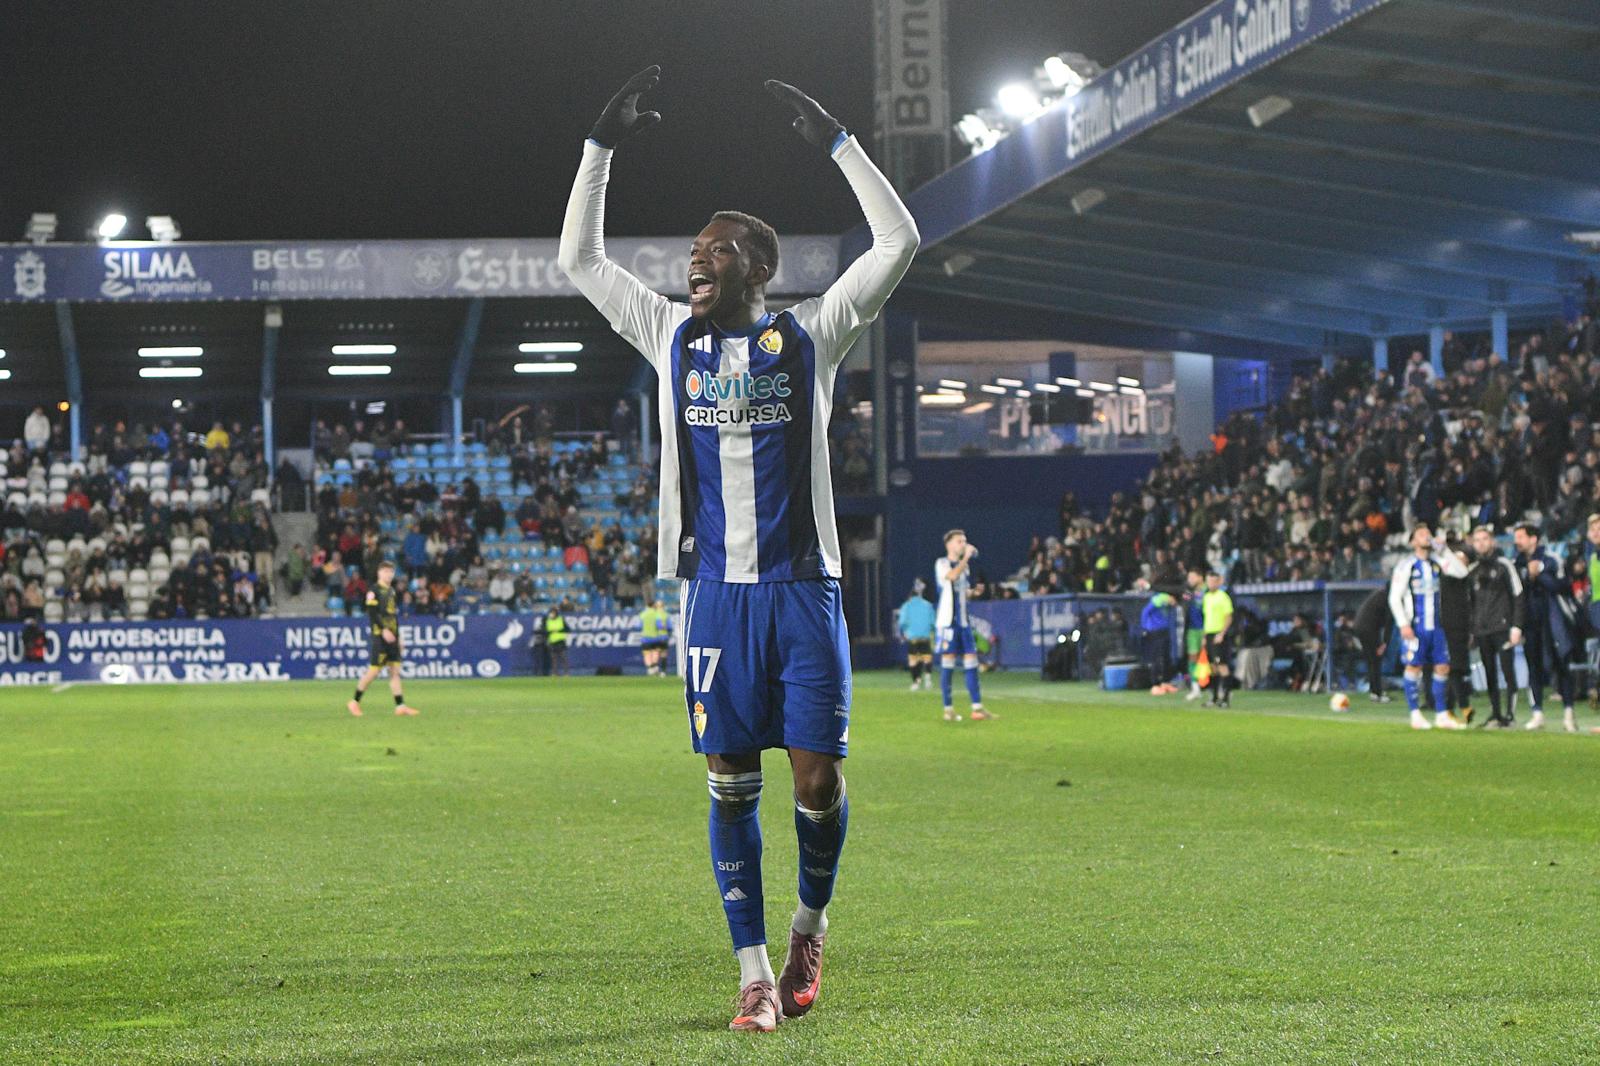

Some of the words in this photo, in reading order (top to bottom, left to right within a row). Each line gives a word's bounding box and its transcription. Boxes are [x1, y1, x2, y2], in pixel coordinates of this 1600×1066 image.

[1176, 15, 1232, 98] Estrella
[104, 251, 196, 279] SILMA
[252, 249, 325, 271] BELS
[686, 404, 792, 426] CRICURSA
[68, 628, 225, 649] AUTOESCUELA
[400, 660, 473, 678] Galicia
[688, 646, 722, 693] 17
[717, 860, 745, 872] SDP
